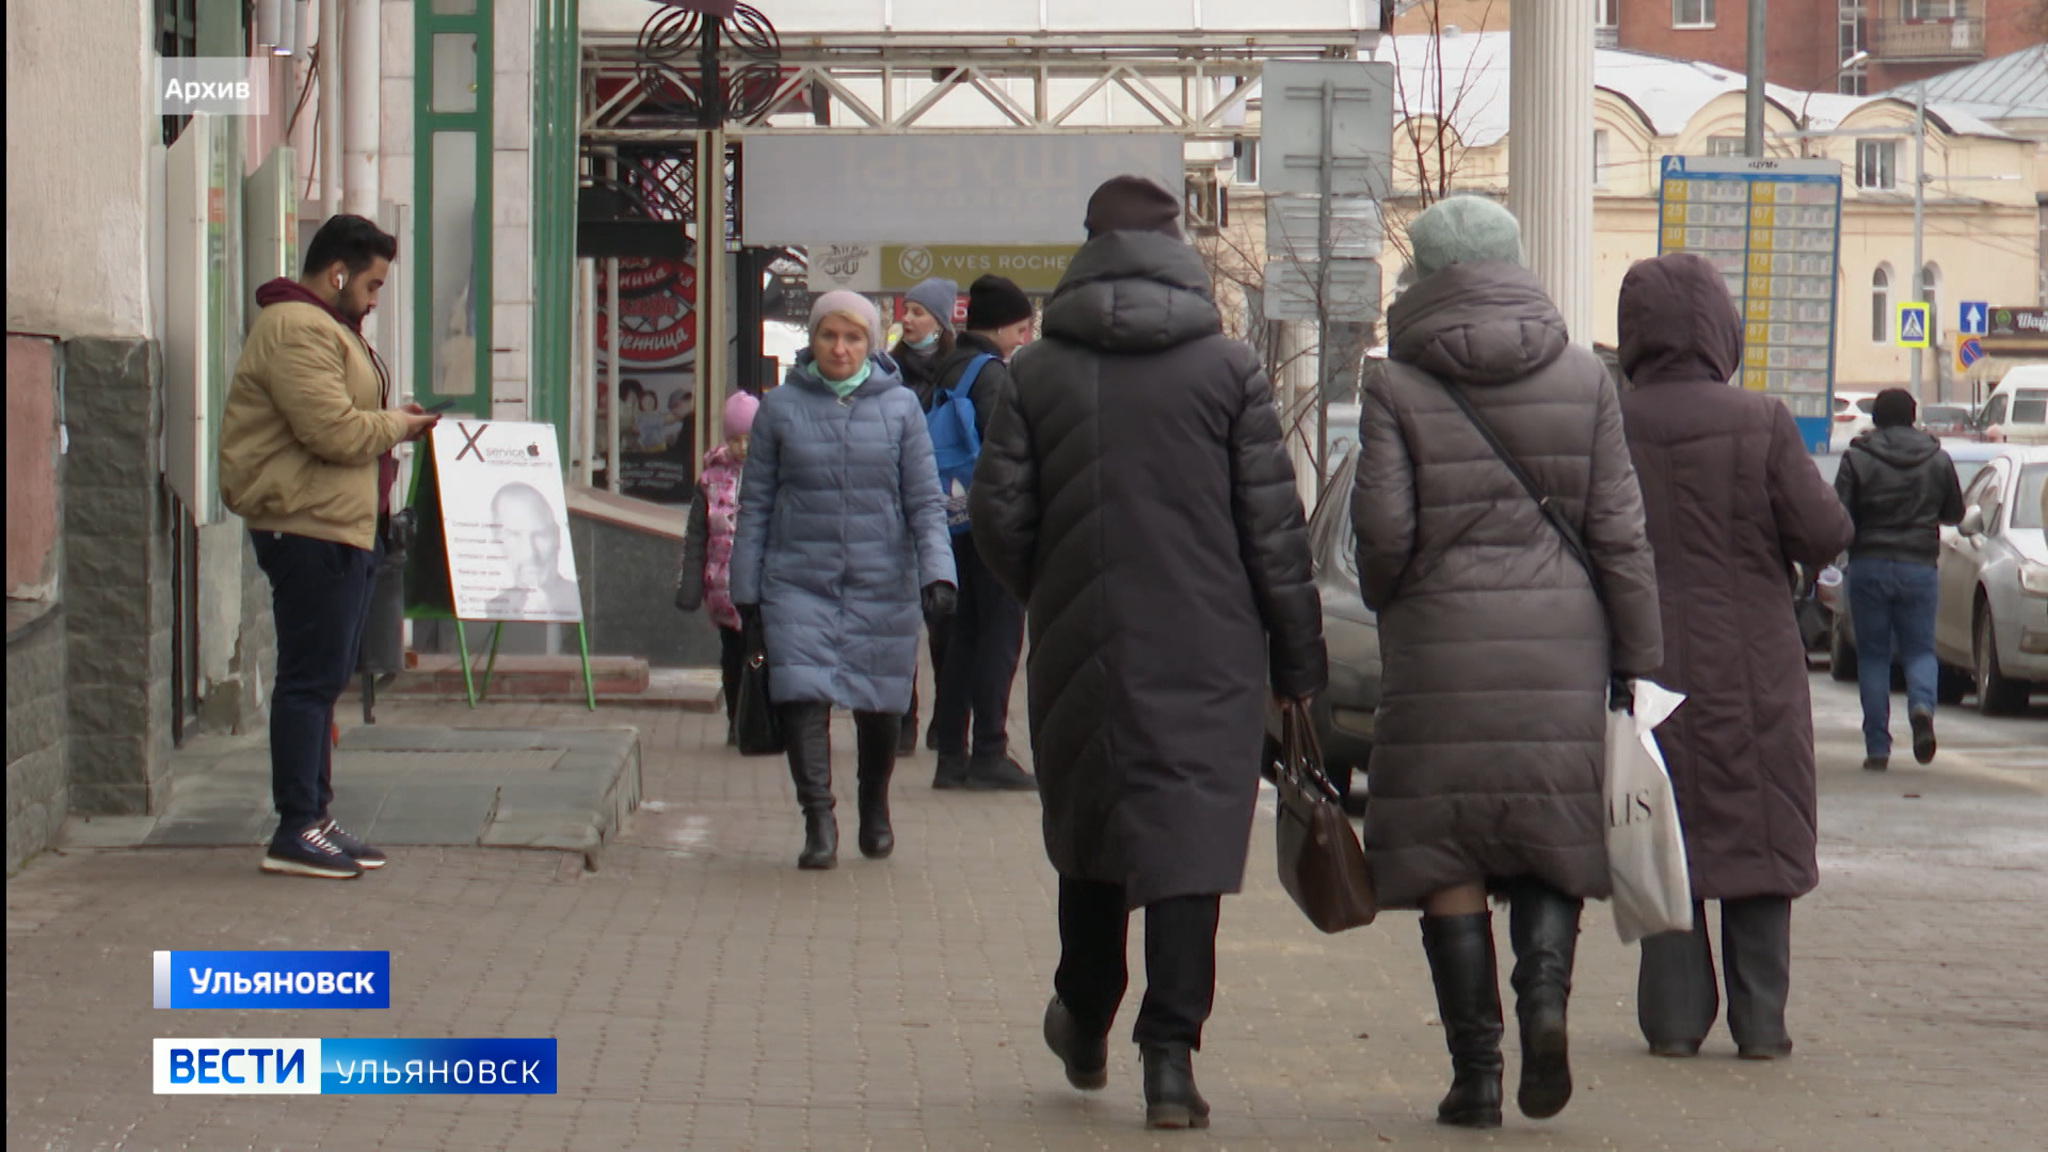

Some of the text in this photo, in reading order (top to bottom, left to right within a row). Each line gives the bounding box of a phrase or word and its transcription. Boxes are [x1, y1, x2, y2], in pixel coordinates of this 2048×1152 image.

[1666, 157, 1682, 171] А
[940, 255, 1075, 270] YVES ROCHE
[455, 422, 525, 463] X service
